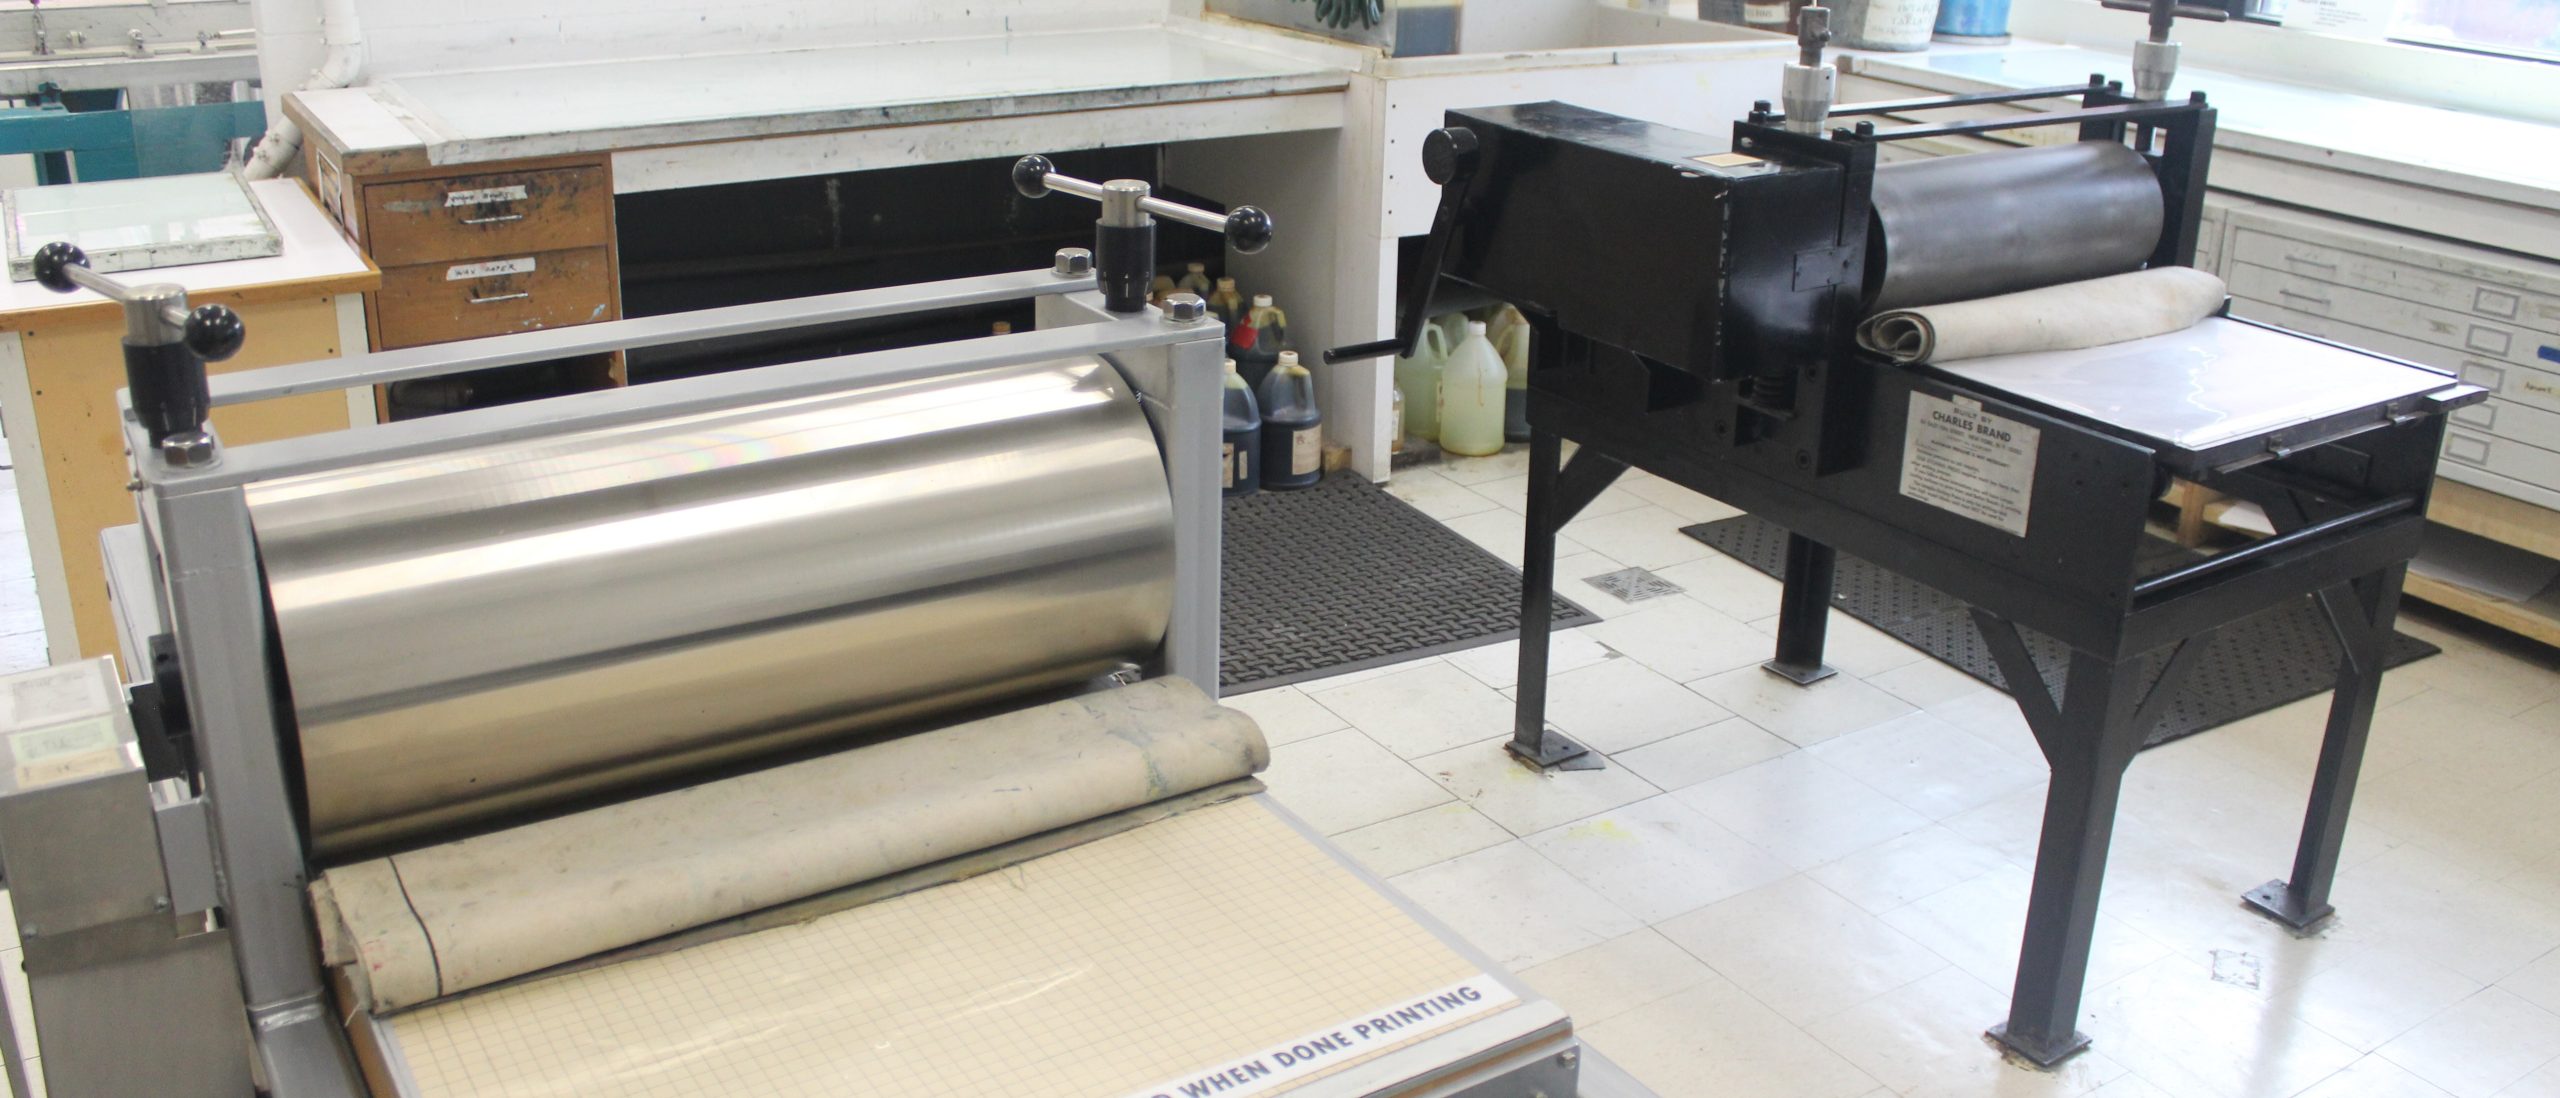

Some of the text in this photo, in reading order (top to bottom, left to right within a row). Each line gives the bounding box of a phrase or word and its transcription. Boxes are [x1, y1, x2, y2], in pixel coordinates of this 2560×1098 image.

[1932, 410, 2011, 443] CHARLES BRAND
[1980, 415, 1992, 424] BY
[1178, 986, 1481, 1098] WHEN DONE PRINTING
